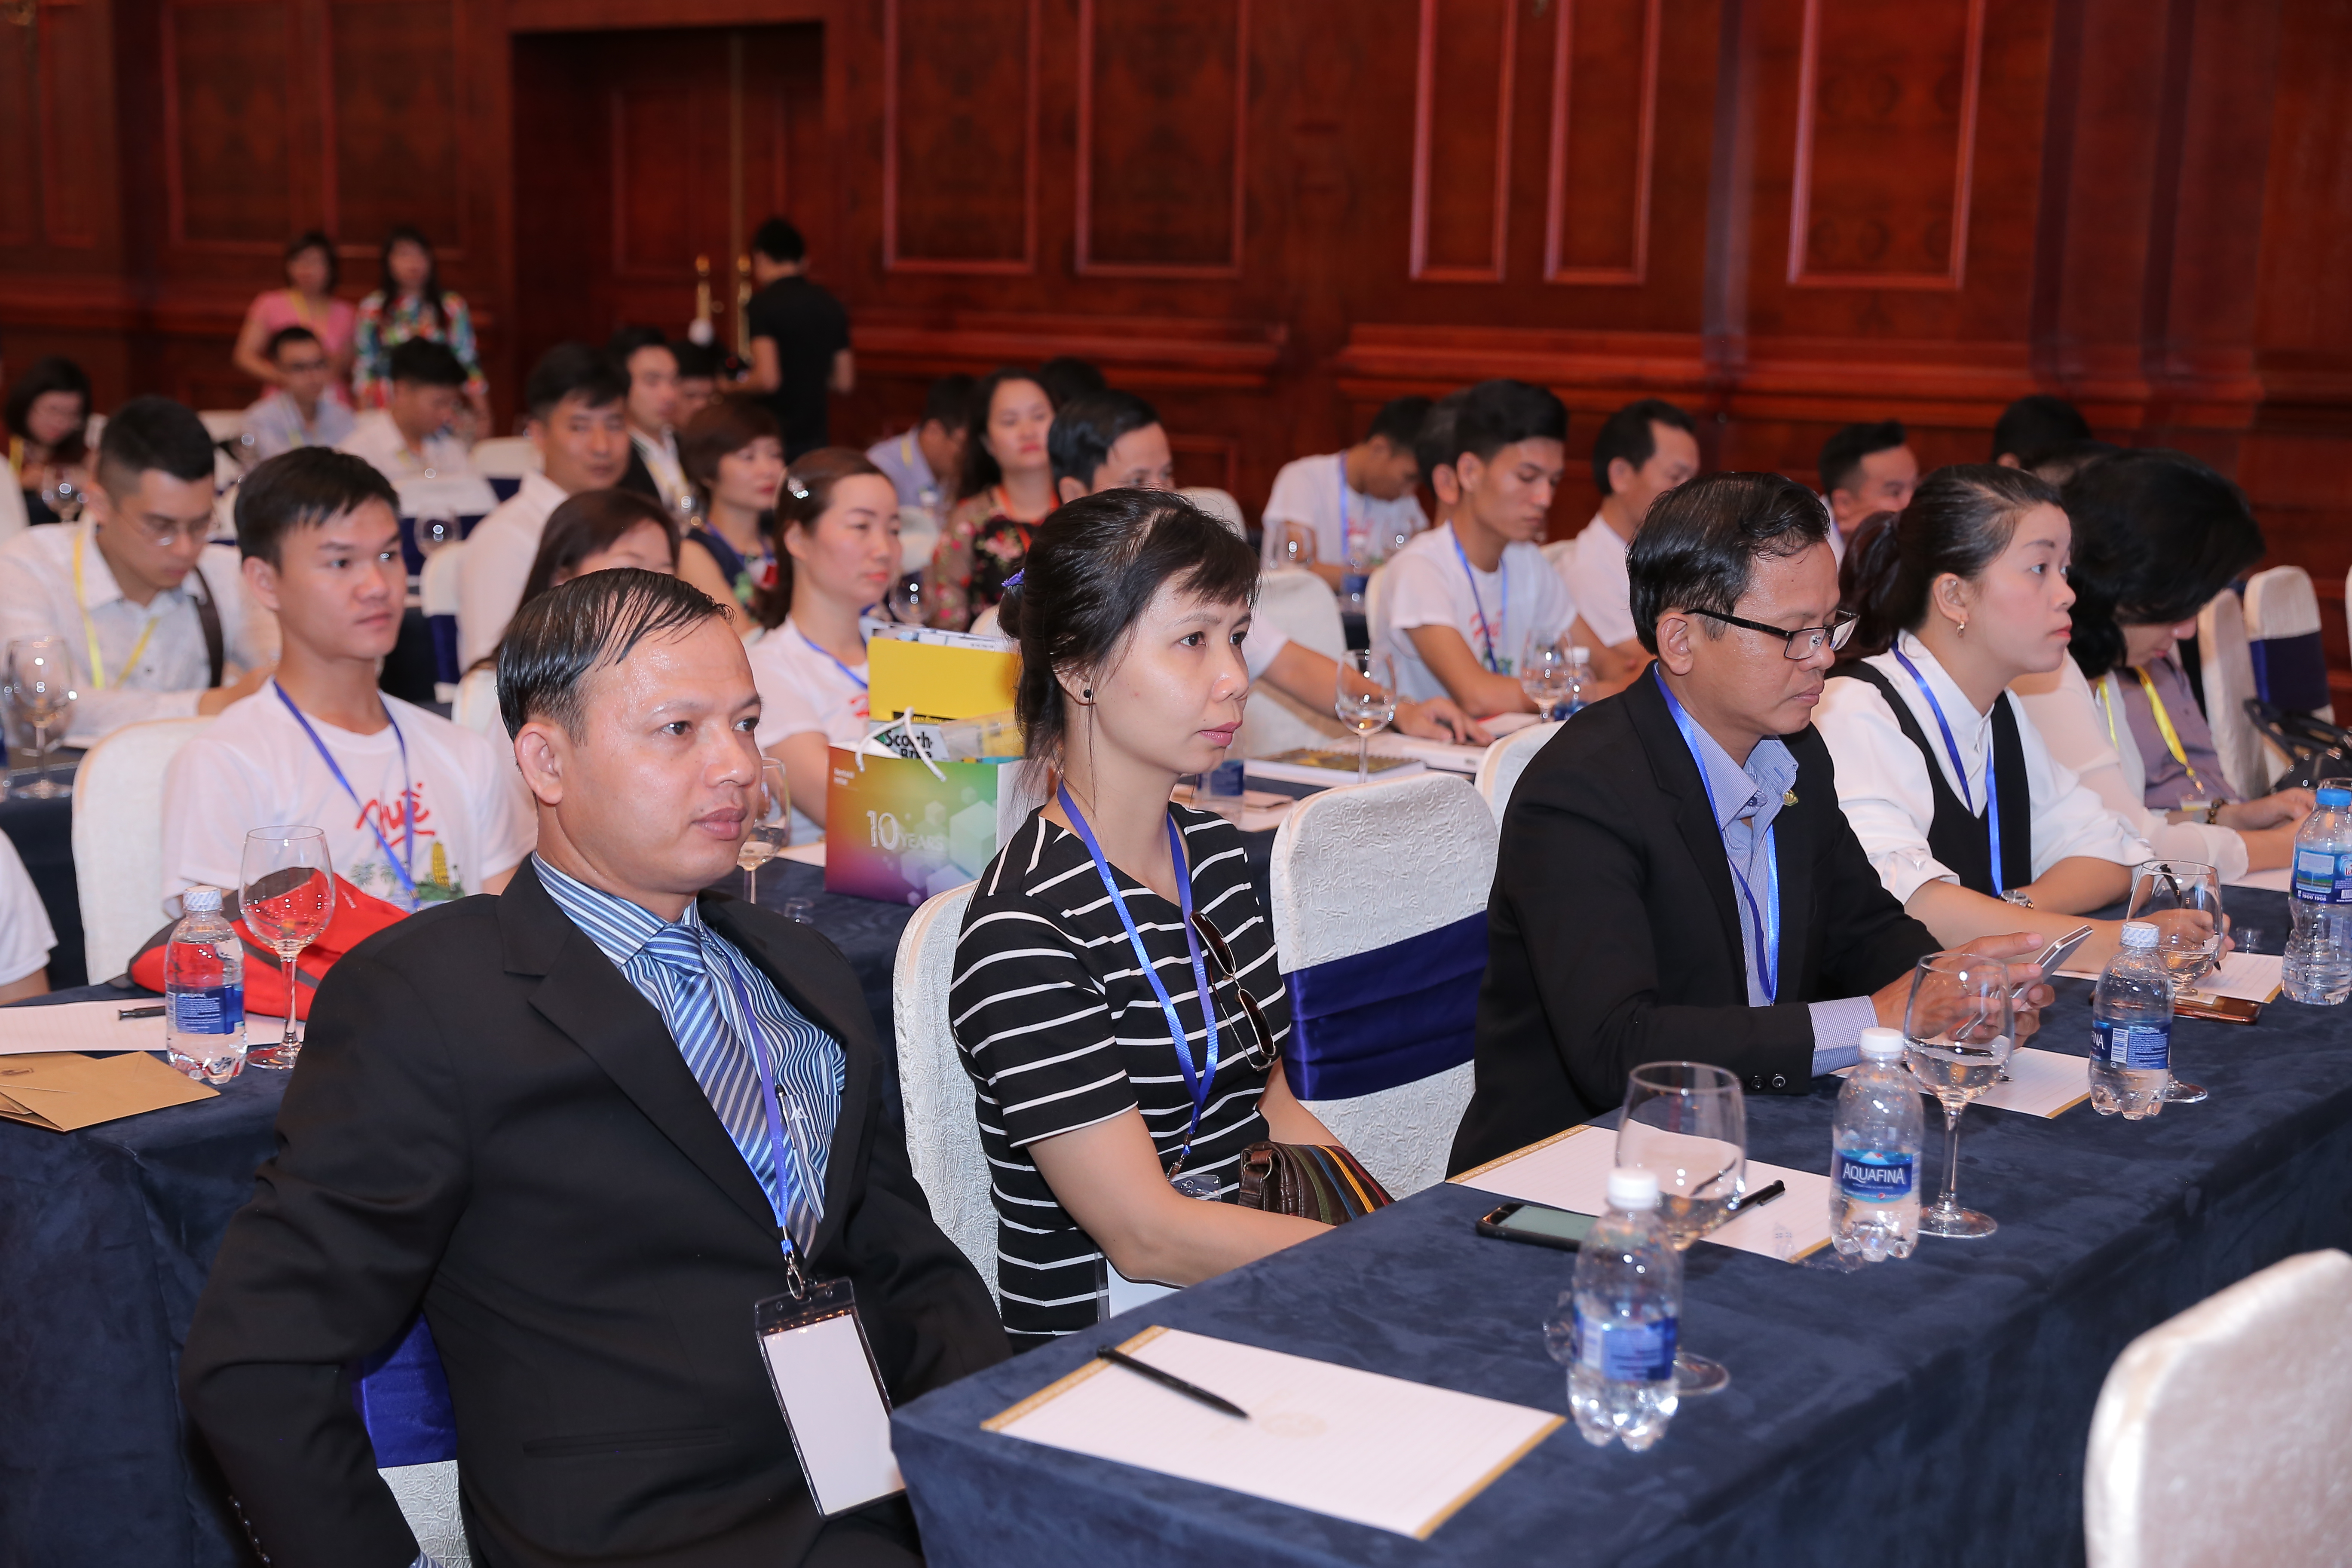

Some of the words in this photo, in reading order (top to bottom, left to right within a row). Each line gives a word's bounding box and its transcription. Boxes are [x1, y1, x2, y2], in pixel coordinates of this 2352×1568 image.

[867, 810, 899, 850] 10
[898, 832, 945, 851] YEARS
[1843, 1163, 1906, 1184] AQUAFINA
